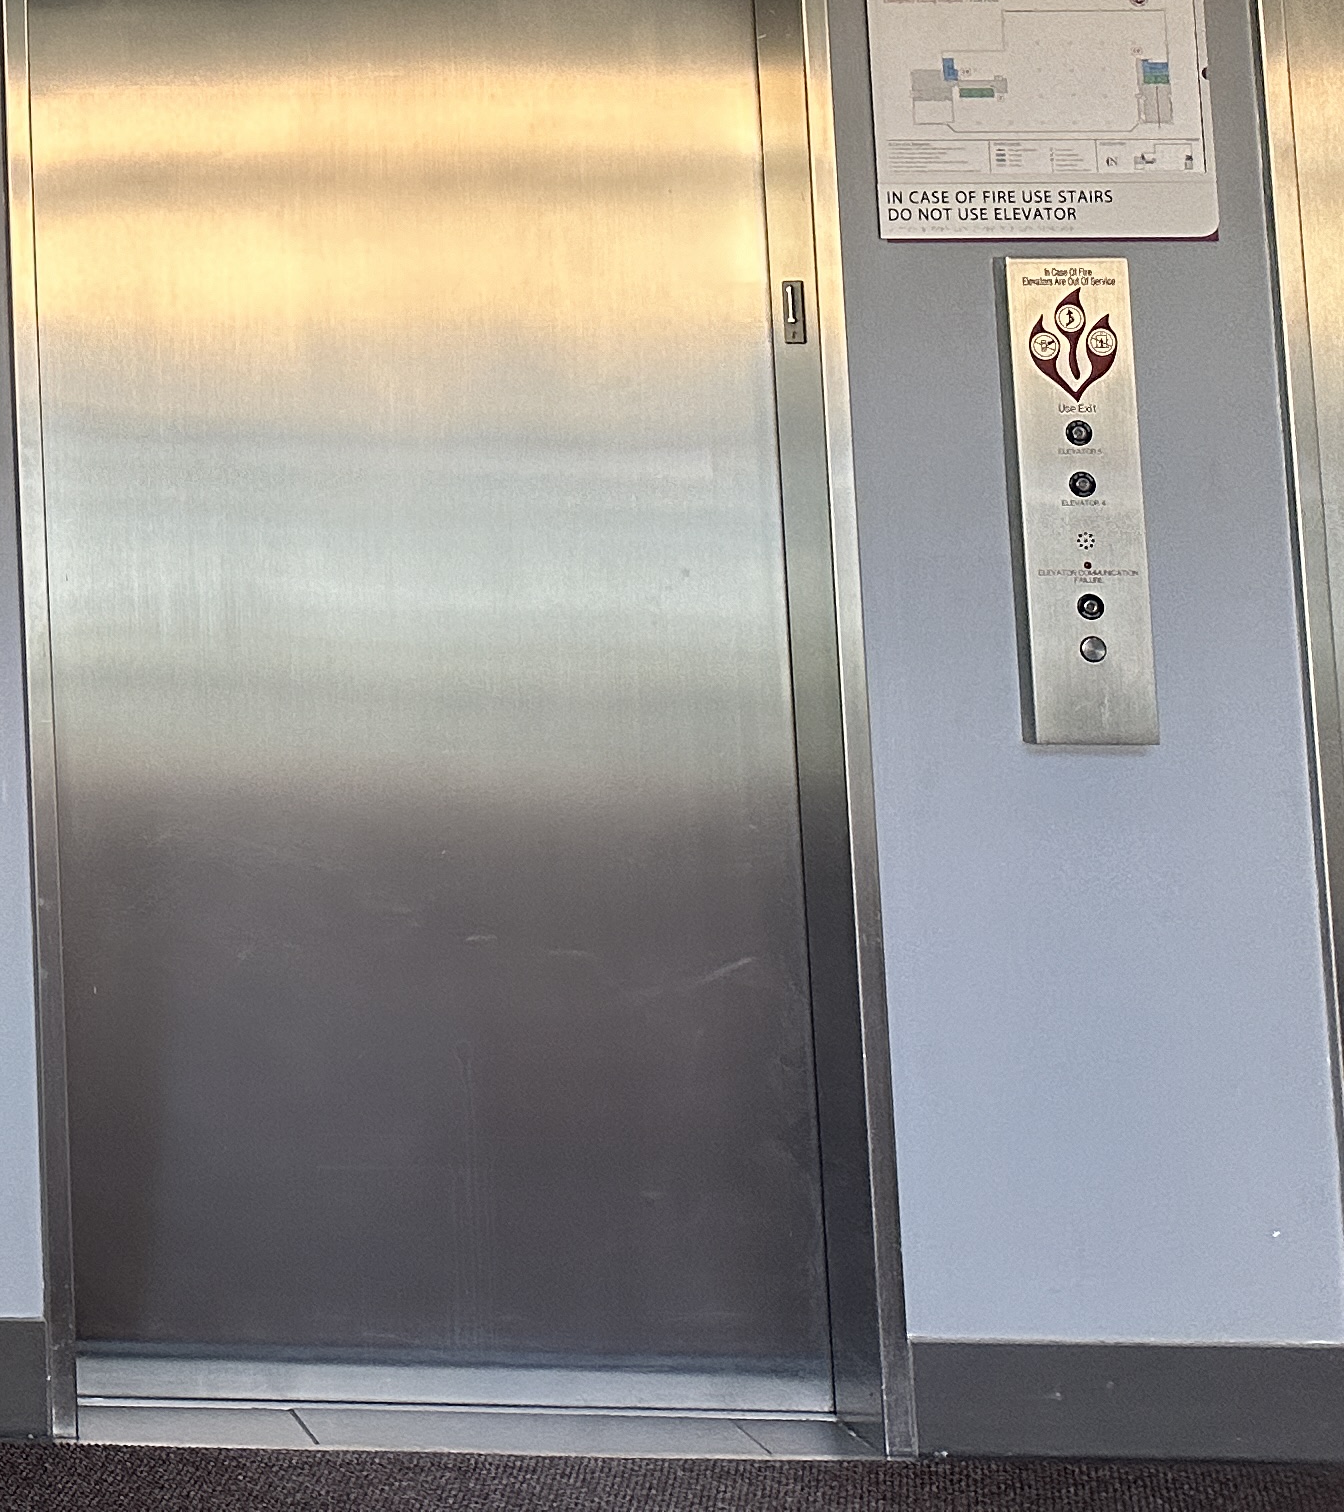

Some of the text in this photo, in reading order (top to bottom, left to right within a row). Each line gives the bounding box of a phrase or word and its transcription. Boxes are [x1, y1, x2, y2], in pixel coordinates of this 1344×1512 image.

[887, 190, 1113, 204] IN CASE OF FIRE USE STAIRS
[888, 207, 1077, 221] DO NOT USE ELEVATOR
[1079, 268, 1092, 276] Fire
[1054, 277, 1066, 286] Are
[1067, 277, 1080, 286] Out
[1090, 277, 1116, 286] Service
[785, 285, 796, 323] 1
[1058, 404, 1097, 413] Use Exit
